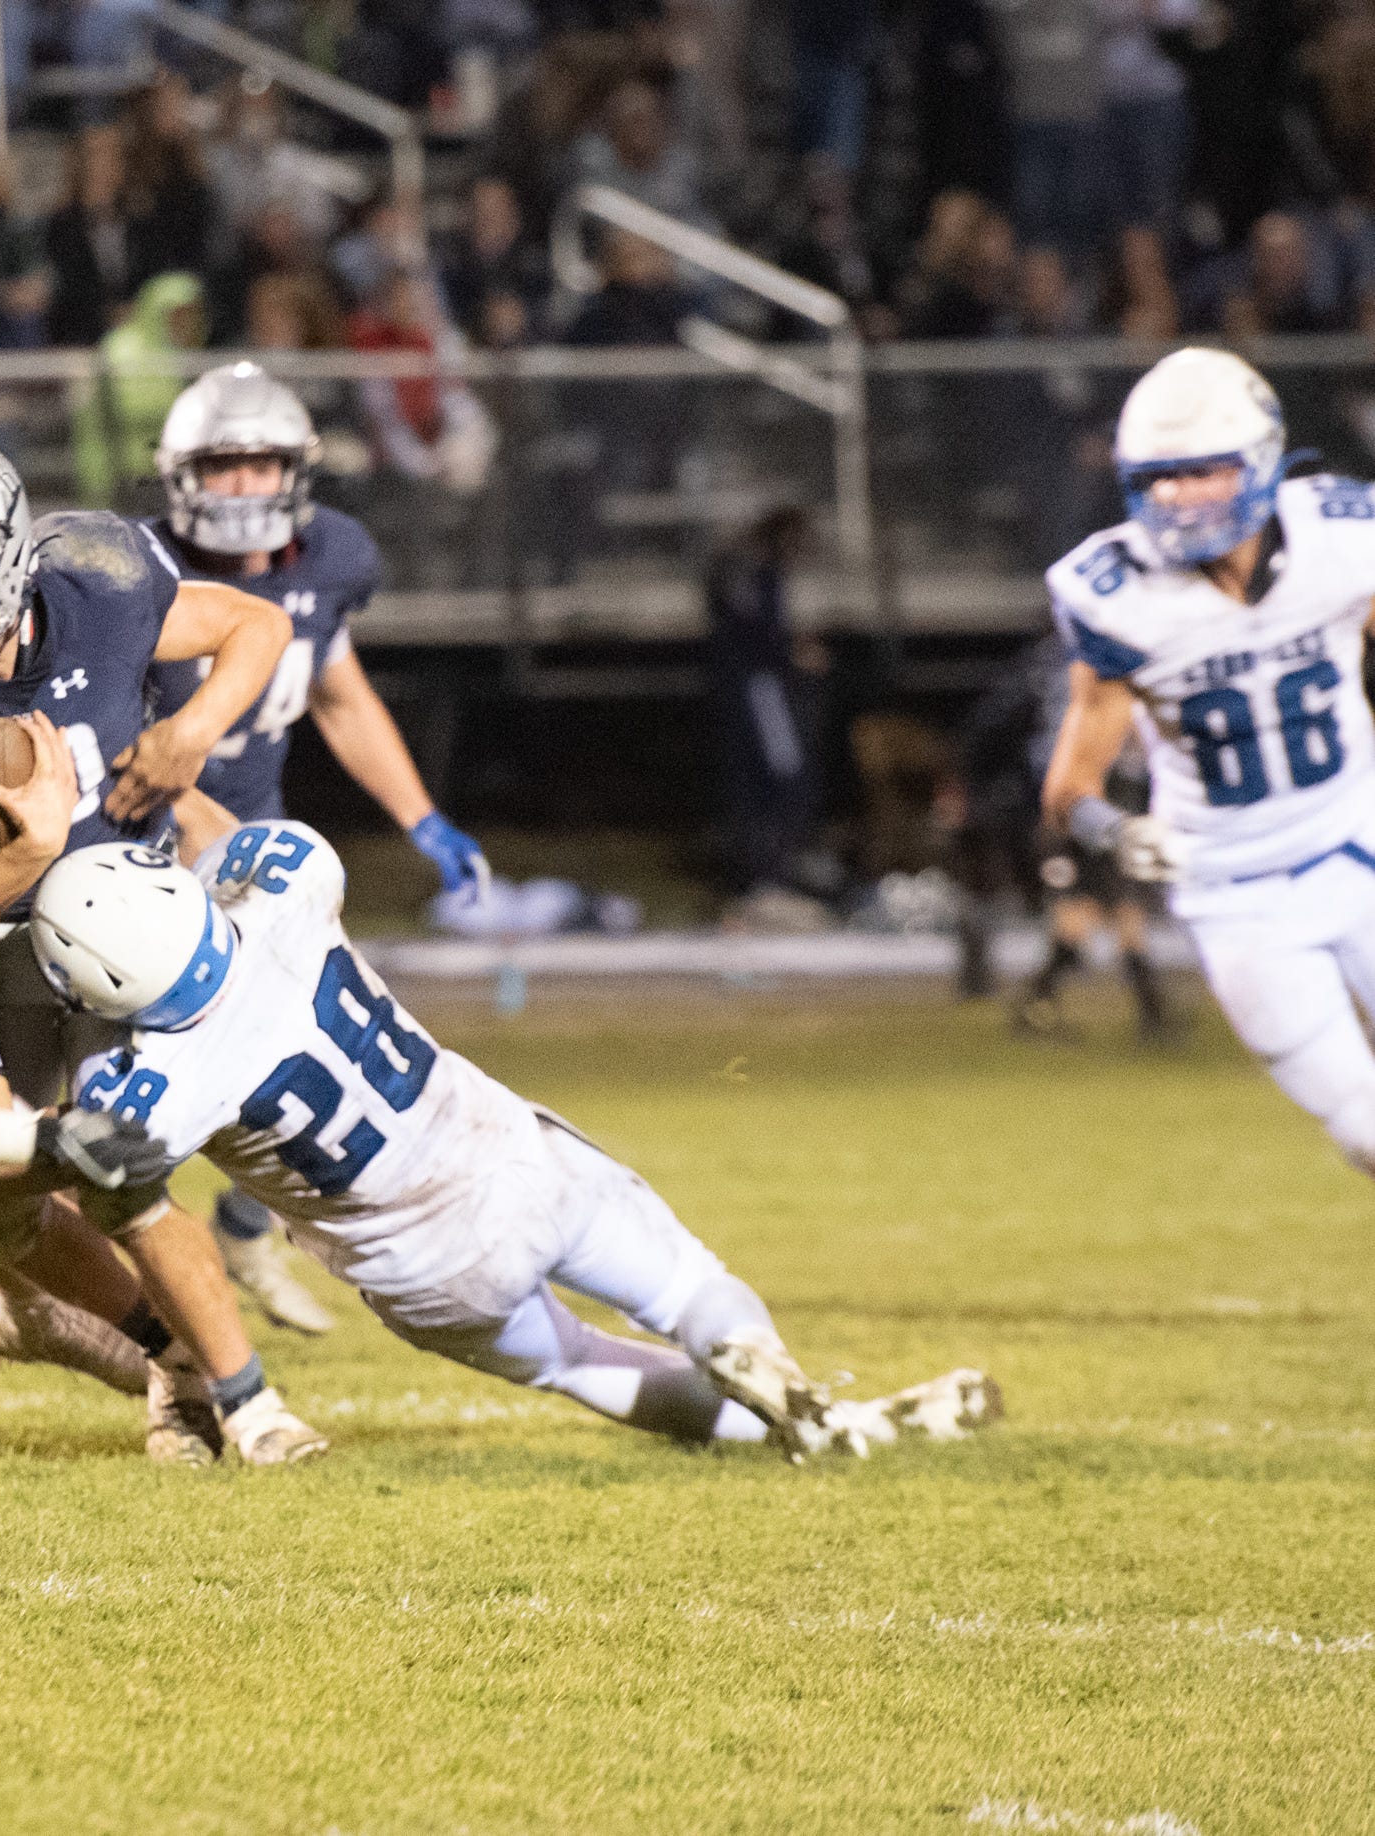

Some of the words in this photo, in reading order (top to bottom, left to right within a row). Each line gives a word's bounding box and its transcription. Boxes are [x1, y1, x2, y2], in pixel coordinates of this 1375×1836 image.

[1179, 659, 1348, 808] 86
[77, 1050, 170, 1124] 28
[238, 944, 439, 1198] 28
